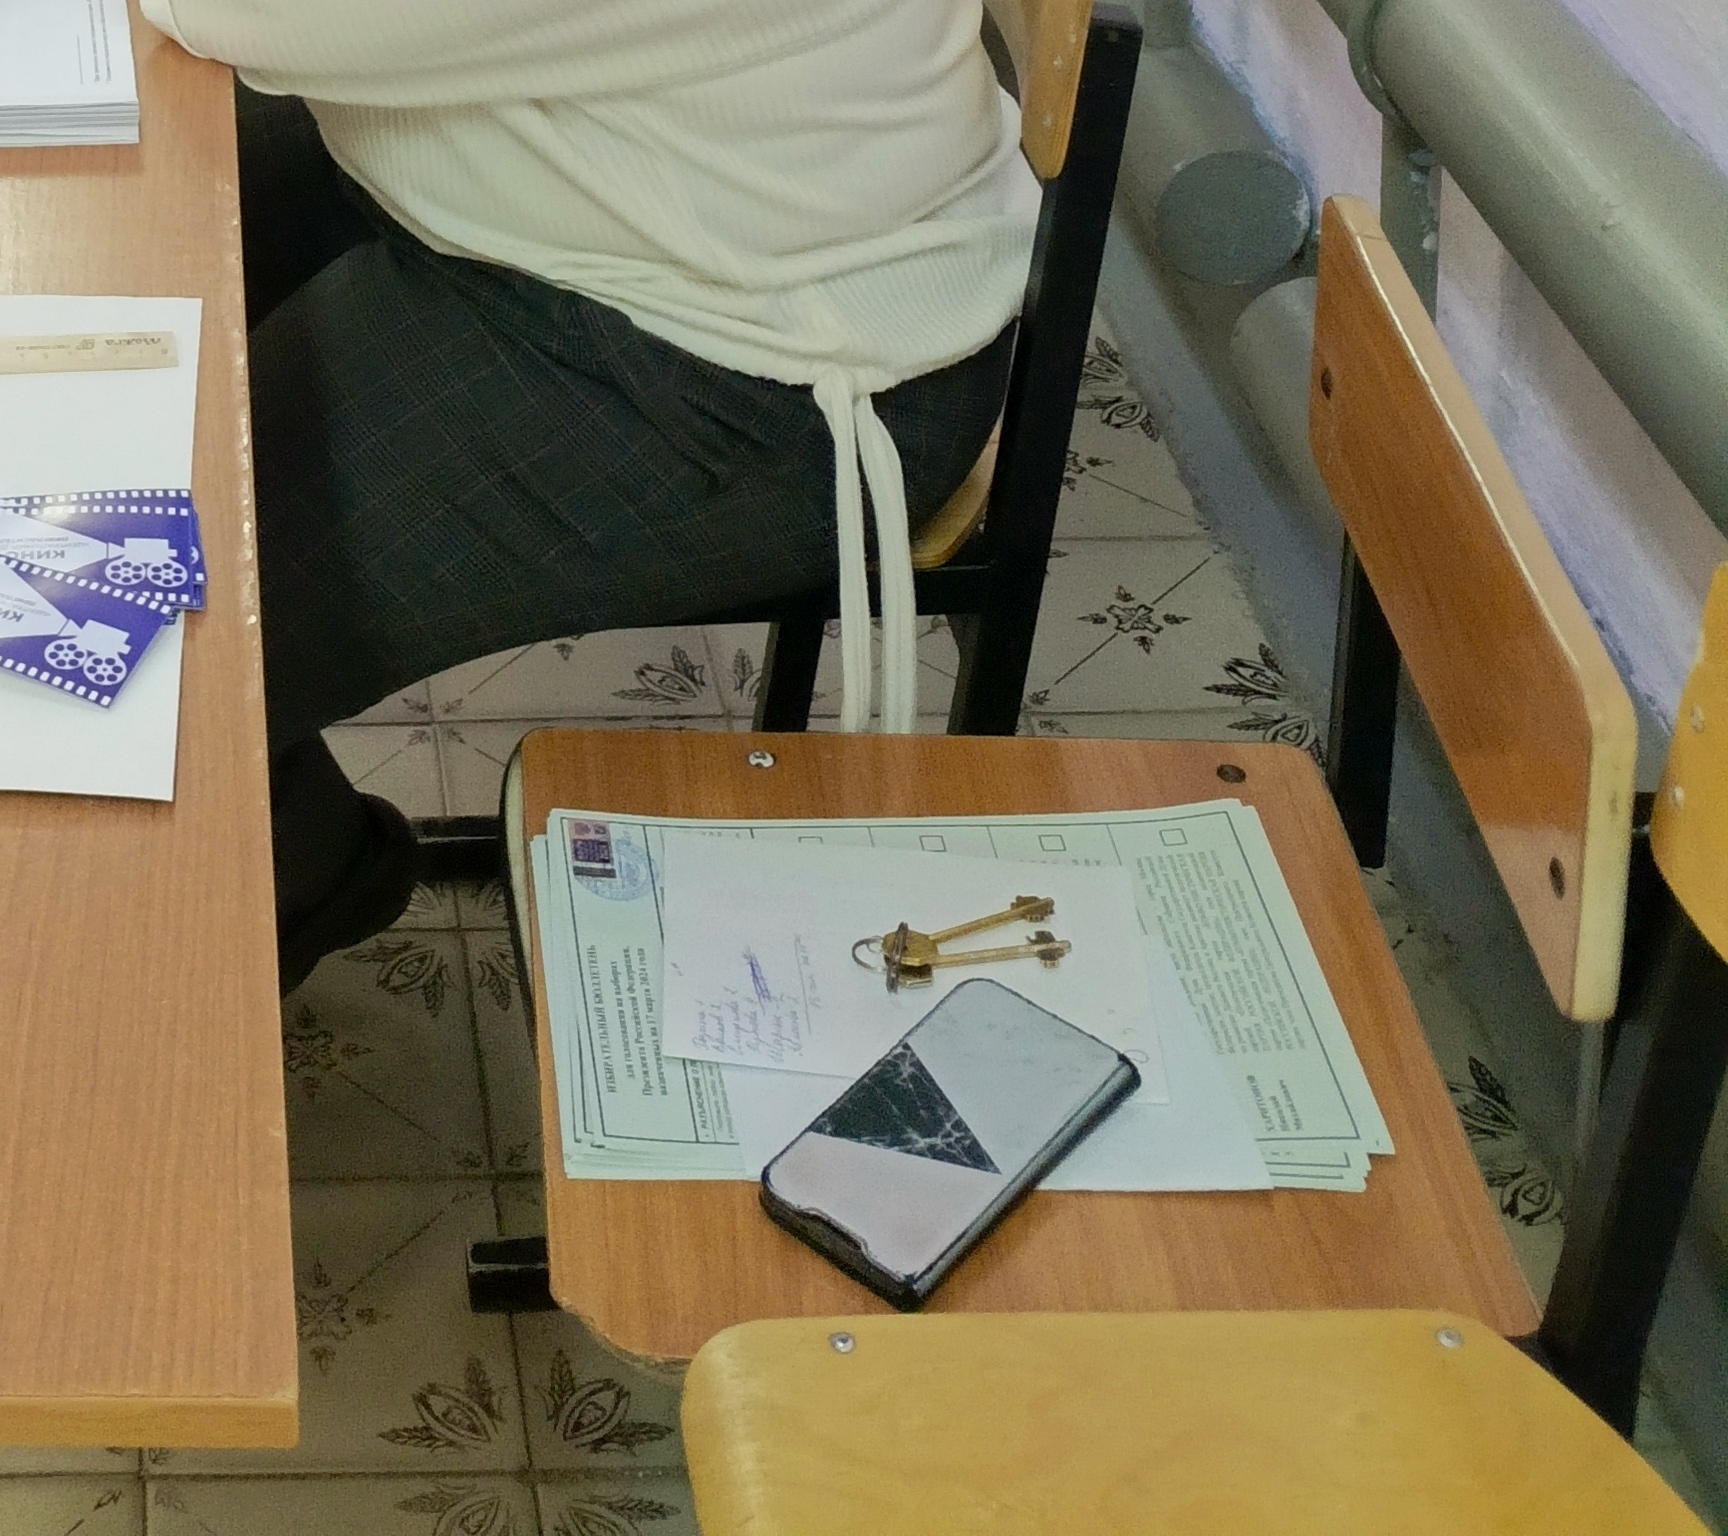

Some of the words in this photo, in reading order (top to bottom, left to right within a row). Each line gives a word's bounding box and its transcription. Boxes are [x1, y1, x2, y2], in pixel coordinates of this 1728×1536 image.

[586, 944, 603, 1005] БЮЛЛЕТЕНЬ
[638, 968, 651, 986] 2024
[628, 996, 644, 1044] Российской
[646, 1015, 656, 1025] 17
[593, 1006, 618, 1093] ИЗБИРАТЕЛЬНЫЙ
[638, 1046, 654, 1096] Президента
